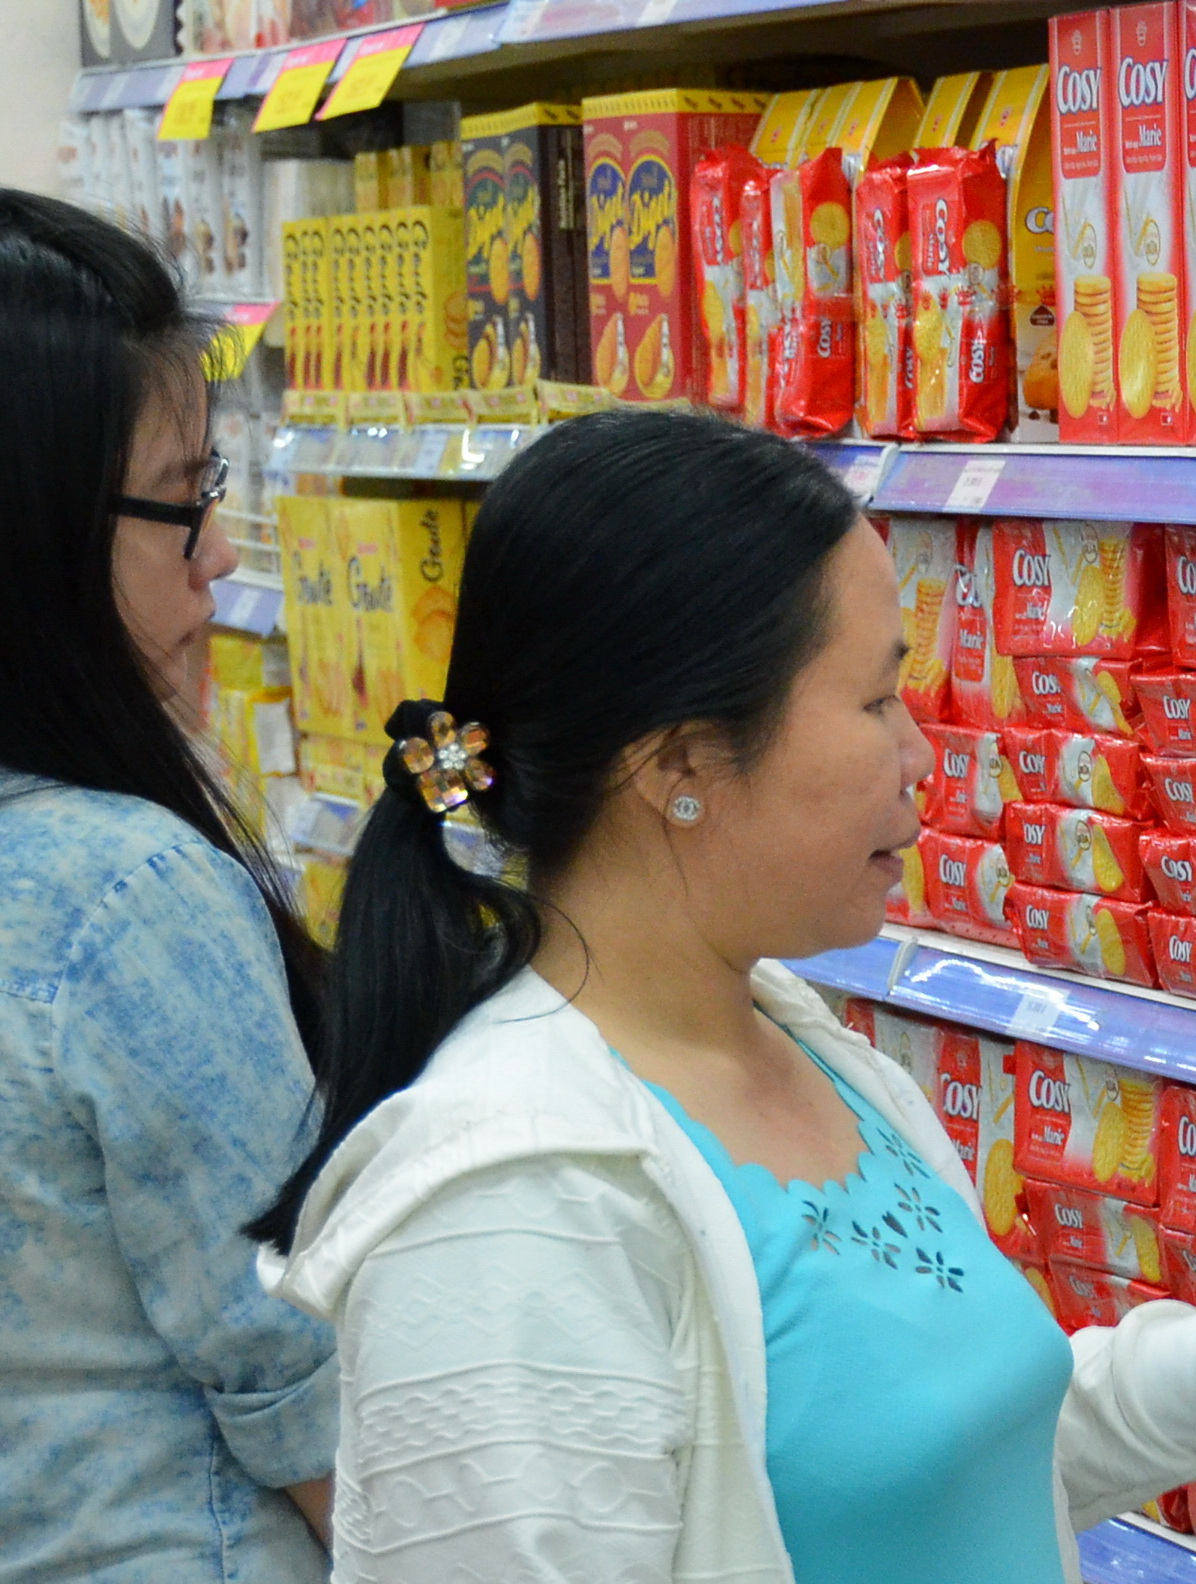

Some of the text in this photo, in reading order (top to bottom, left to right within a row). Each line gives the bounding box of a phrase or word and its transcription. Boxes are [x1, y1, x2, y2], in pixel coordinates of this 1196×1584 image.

[1163, 695, 1191, 720] COSY
[1023, 823, 1046, 846] OSY
[939, 854, 968, 888] COSY
[1026, 904, 1050, 931] COSY
[1028, 1068, 1072, 1115] COSY
